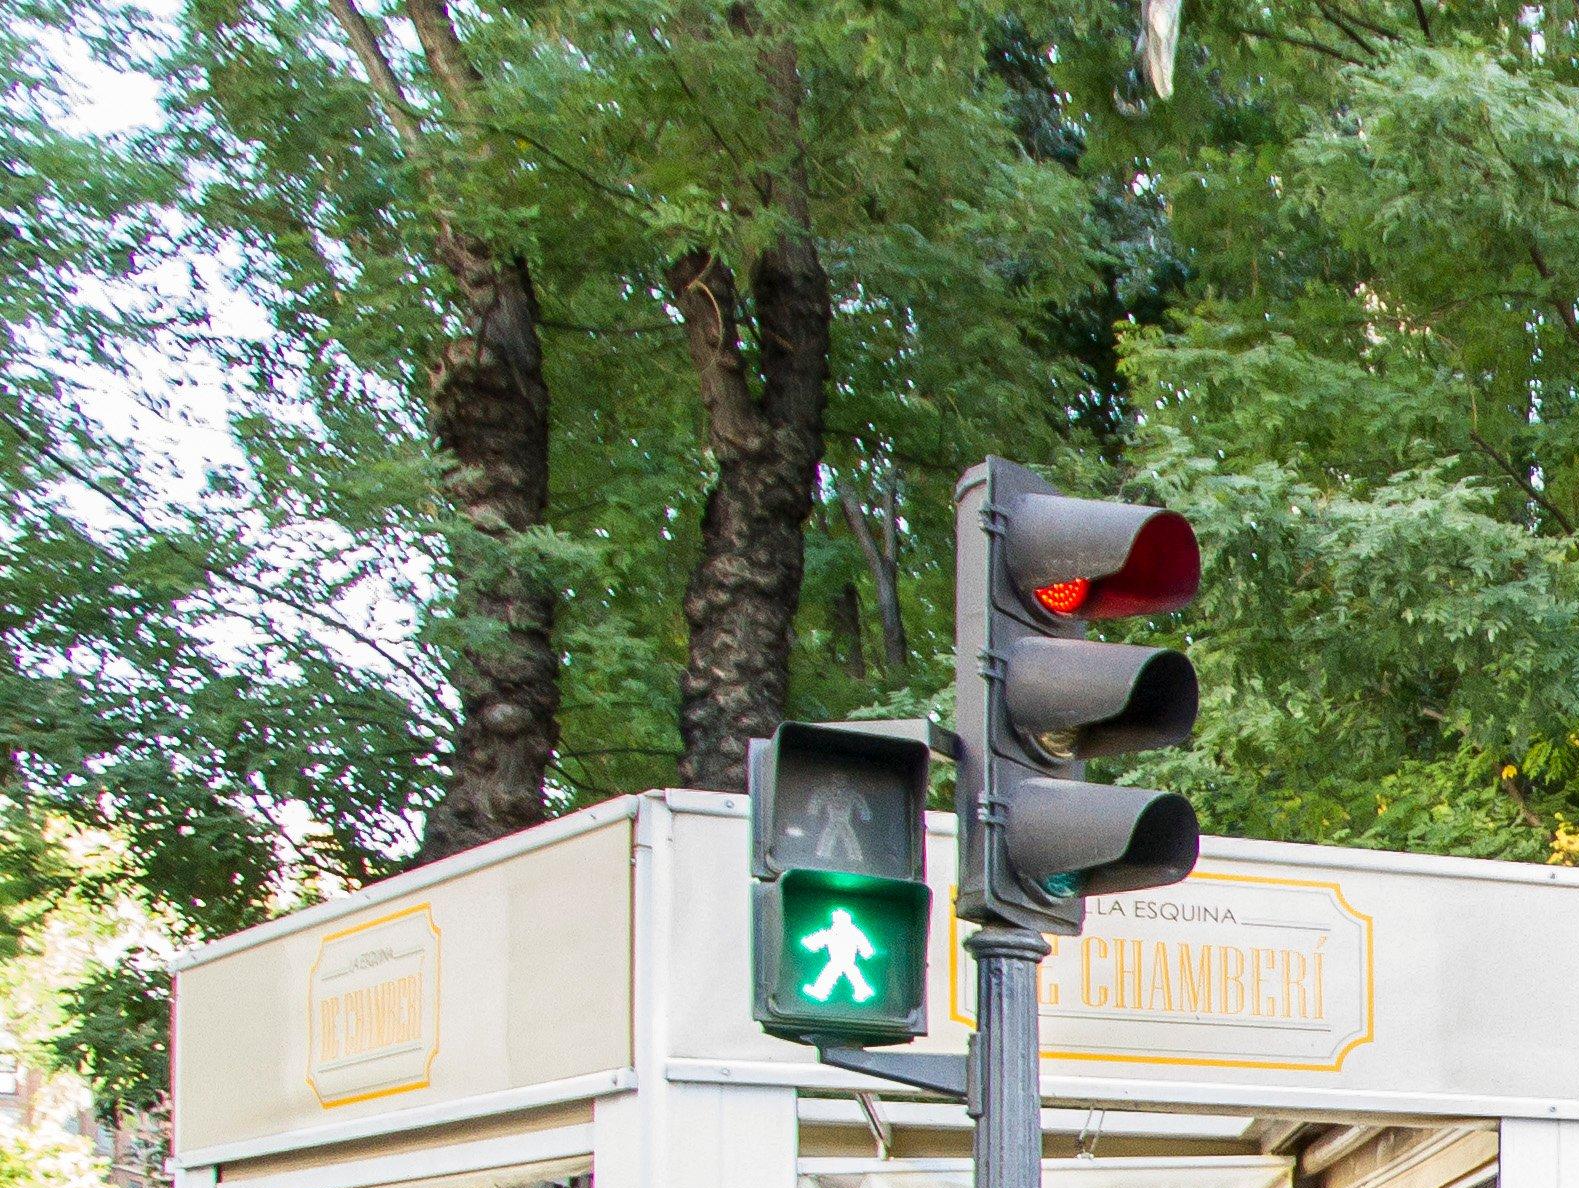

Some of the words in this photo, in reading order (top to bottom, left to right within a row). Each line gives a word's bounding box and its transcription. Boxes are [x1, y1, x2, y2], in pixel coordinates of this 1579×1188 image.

[1097, 898, 1126, 917] LA
[1134, 901, 1237, 924] ESQUINA
[1080, 934, 1329, 1021] CHAMBERÍ
